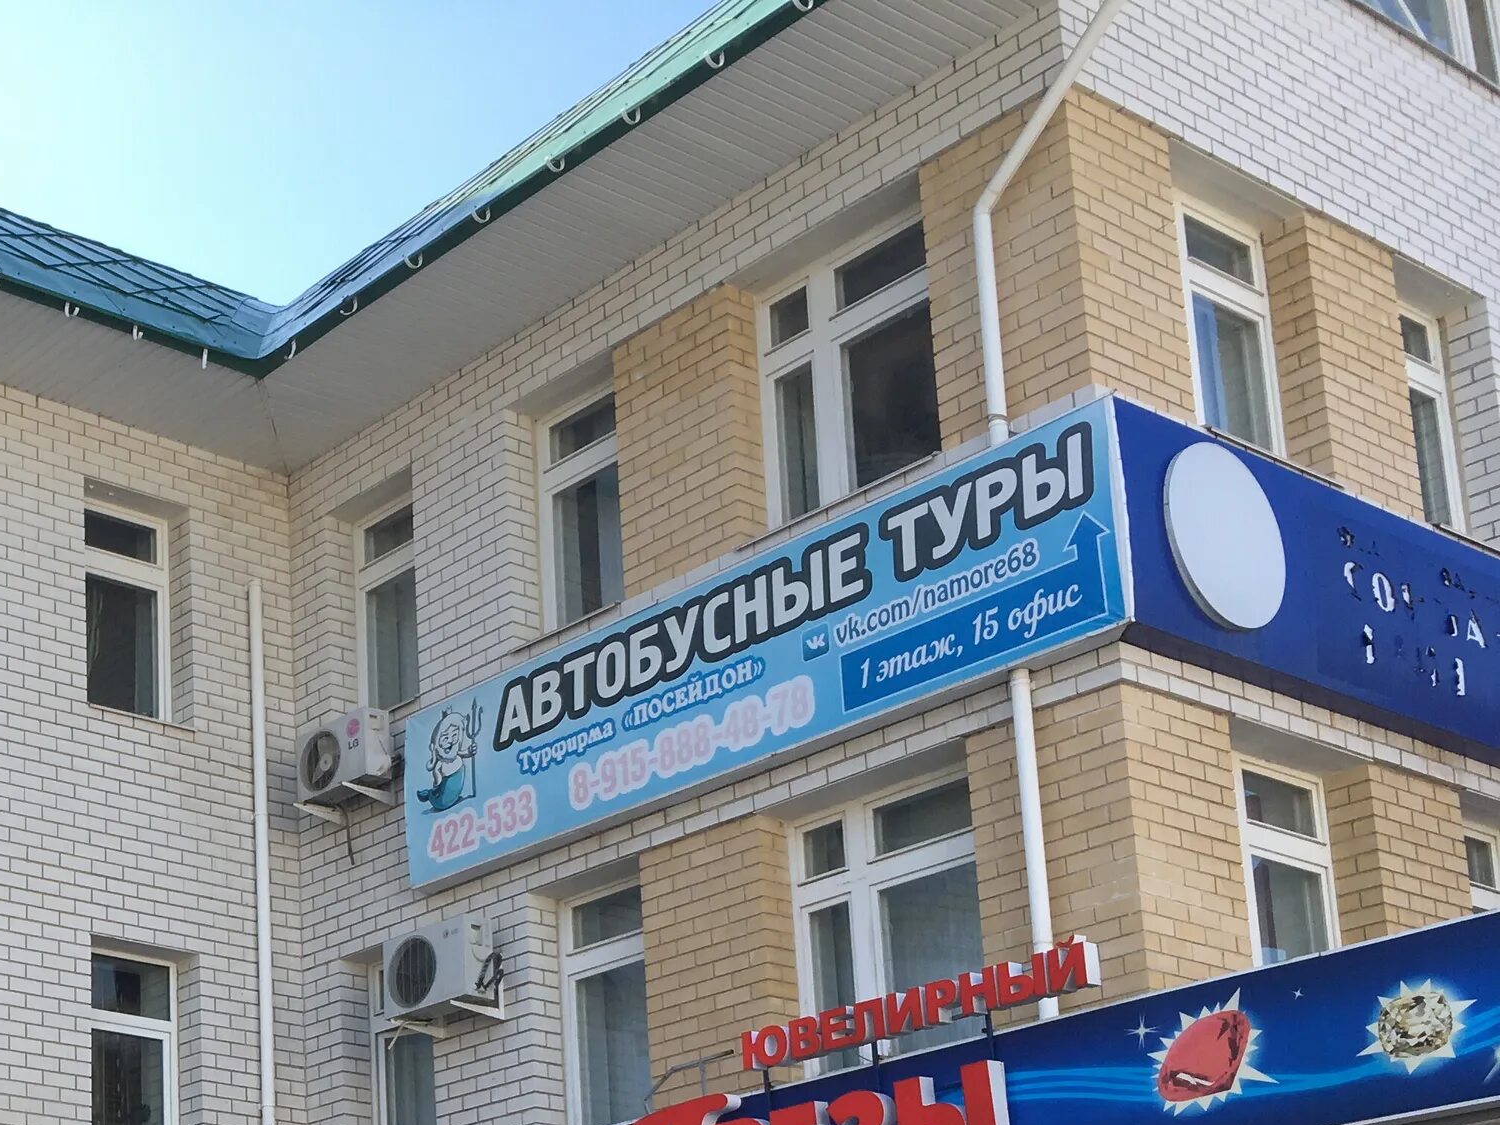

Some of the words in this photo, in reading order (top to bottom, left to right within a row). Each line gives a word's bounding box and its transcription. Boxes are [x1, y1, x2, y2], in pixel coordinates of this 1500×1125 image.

[497, 530, 868, 745] АВТОБУСНЫЕ
[884, 430, 1088, 574] ТУРЫ
[836, 541, 1038, 644] vk.com/namore68
[861, 663, 870, 689] 1
[875, 632, 964, 683] этаж,
[972, 606, 999, 645] 15
[1007, 583, 1083, 639] офис
[348, 738, 359, 750] LG
[519, 722, 615, 773] Турфирма
[625, 660, 763, 727] «ПОСЕЙДОН»
[429, 790, 534, 858] 422-533
[741, 936, 1094, 1071] ЮВЕЛИРНЫЙ
